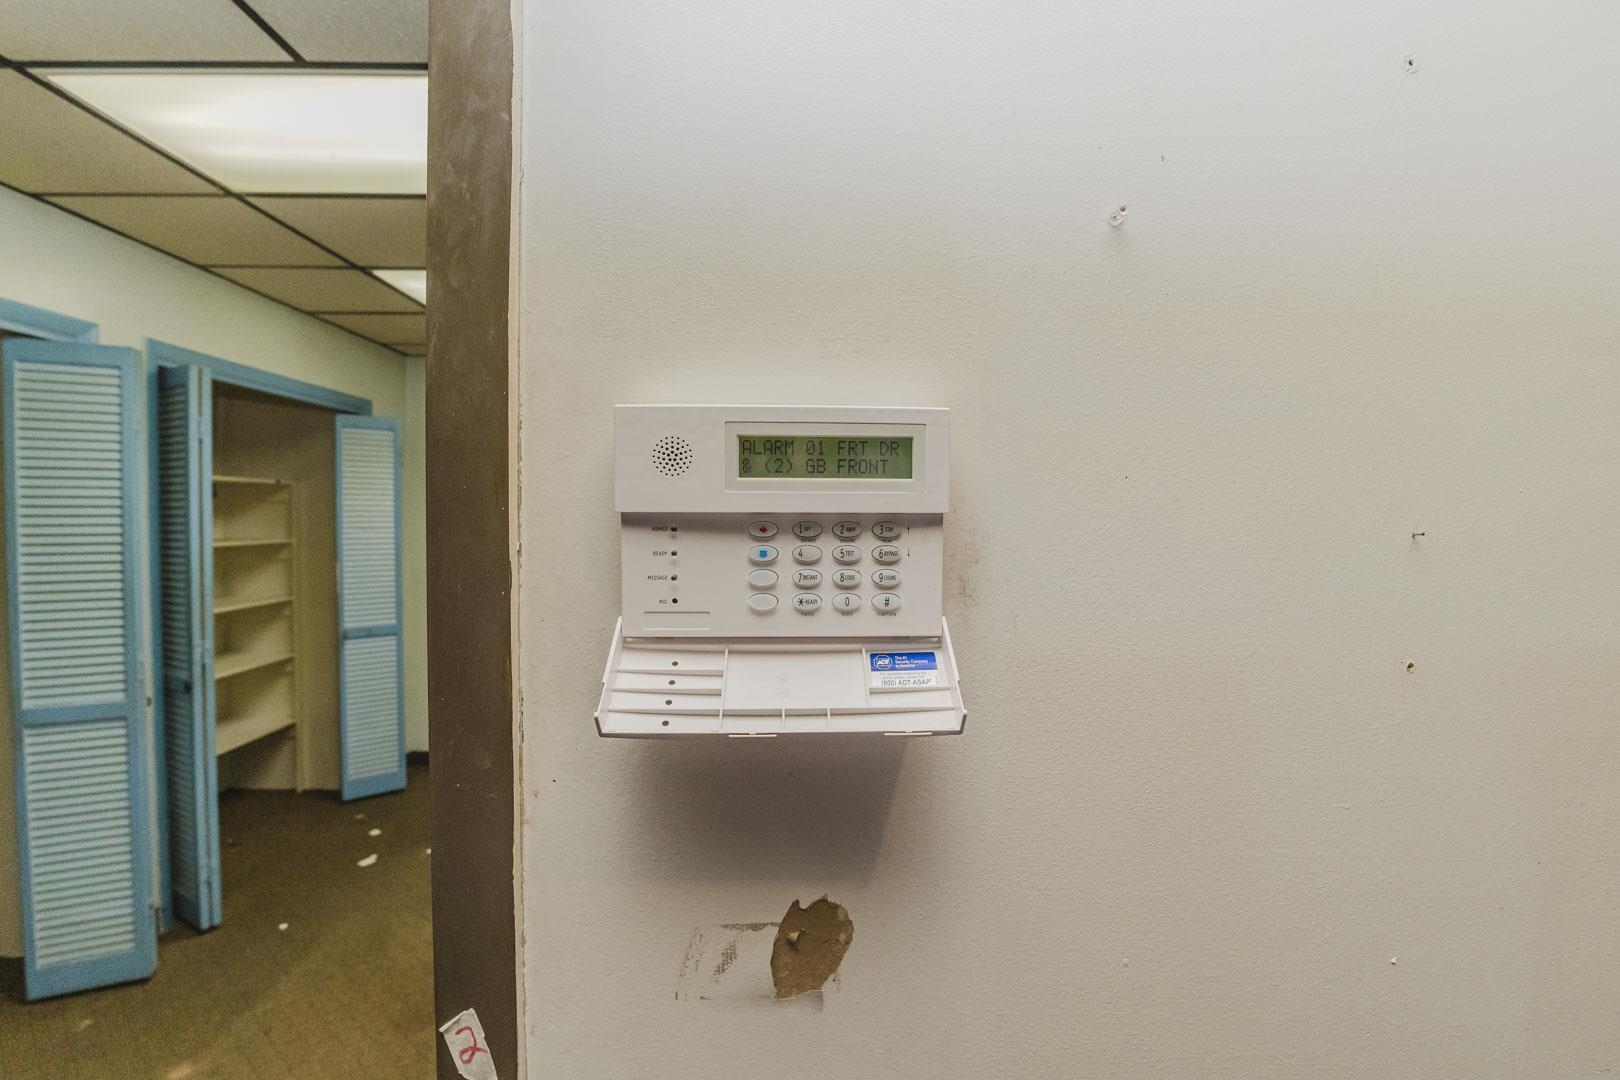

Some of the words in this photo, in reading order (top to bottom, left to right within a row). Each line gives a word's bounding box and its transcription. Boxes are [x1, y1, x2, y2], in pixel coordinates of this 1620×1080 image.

[742, 440, 794, 455] ALARM
[806, 440, 825, 456] 01
[837, 440, 868, 456] FRT
[879, 441, 900, 456] DR
[764, 458, 793, 474] (2)
[805, 459, 826, 474] GB
[837, 459, 889, 474] FRONT
[455, 1026, 489, 1065] 2
